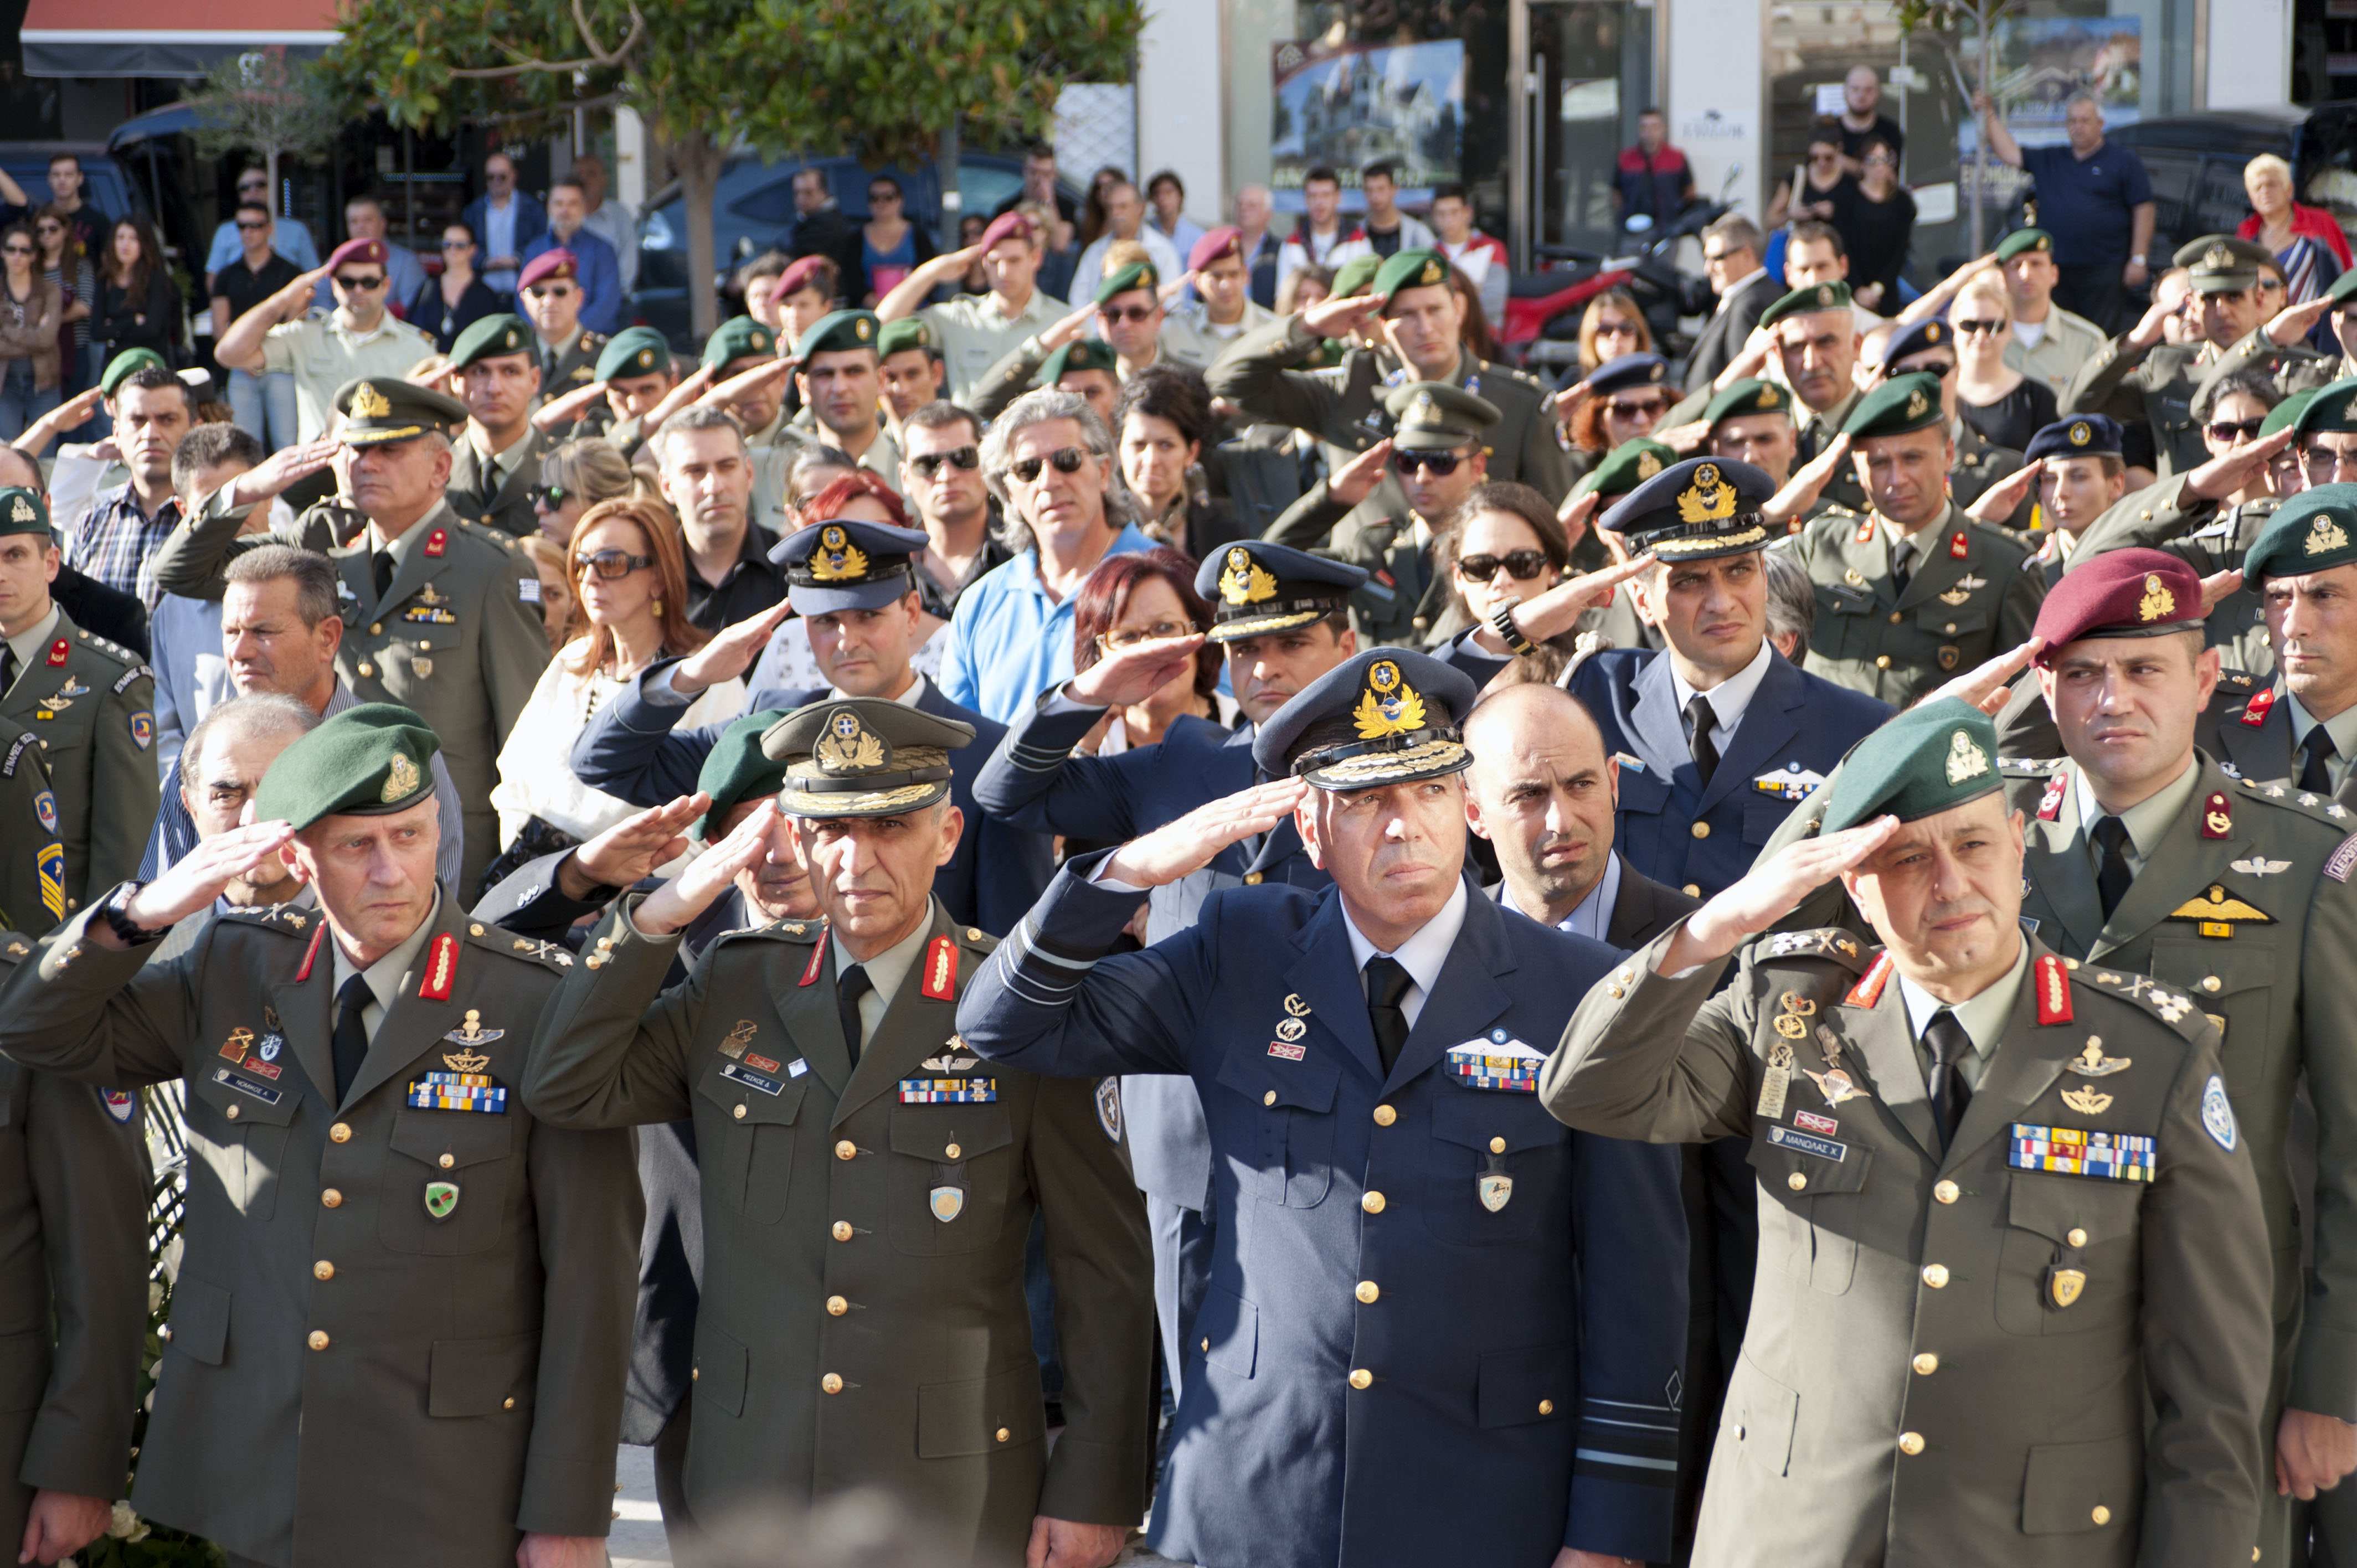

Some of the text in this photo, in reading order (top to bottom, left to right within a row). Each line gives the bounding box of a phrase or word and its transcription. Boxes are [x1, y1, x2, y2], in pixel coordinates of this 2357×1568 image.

[235, 1079, 263, 1094] ΝΟΜΙΚΟΣ
[1785, 1135, 1838, 1156] ΜΑΝΩΛΑΣ Χ
